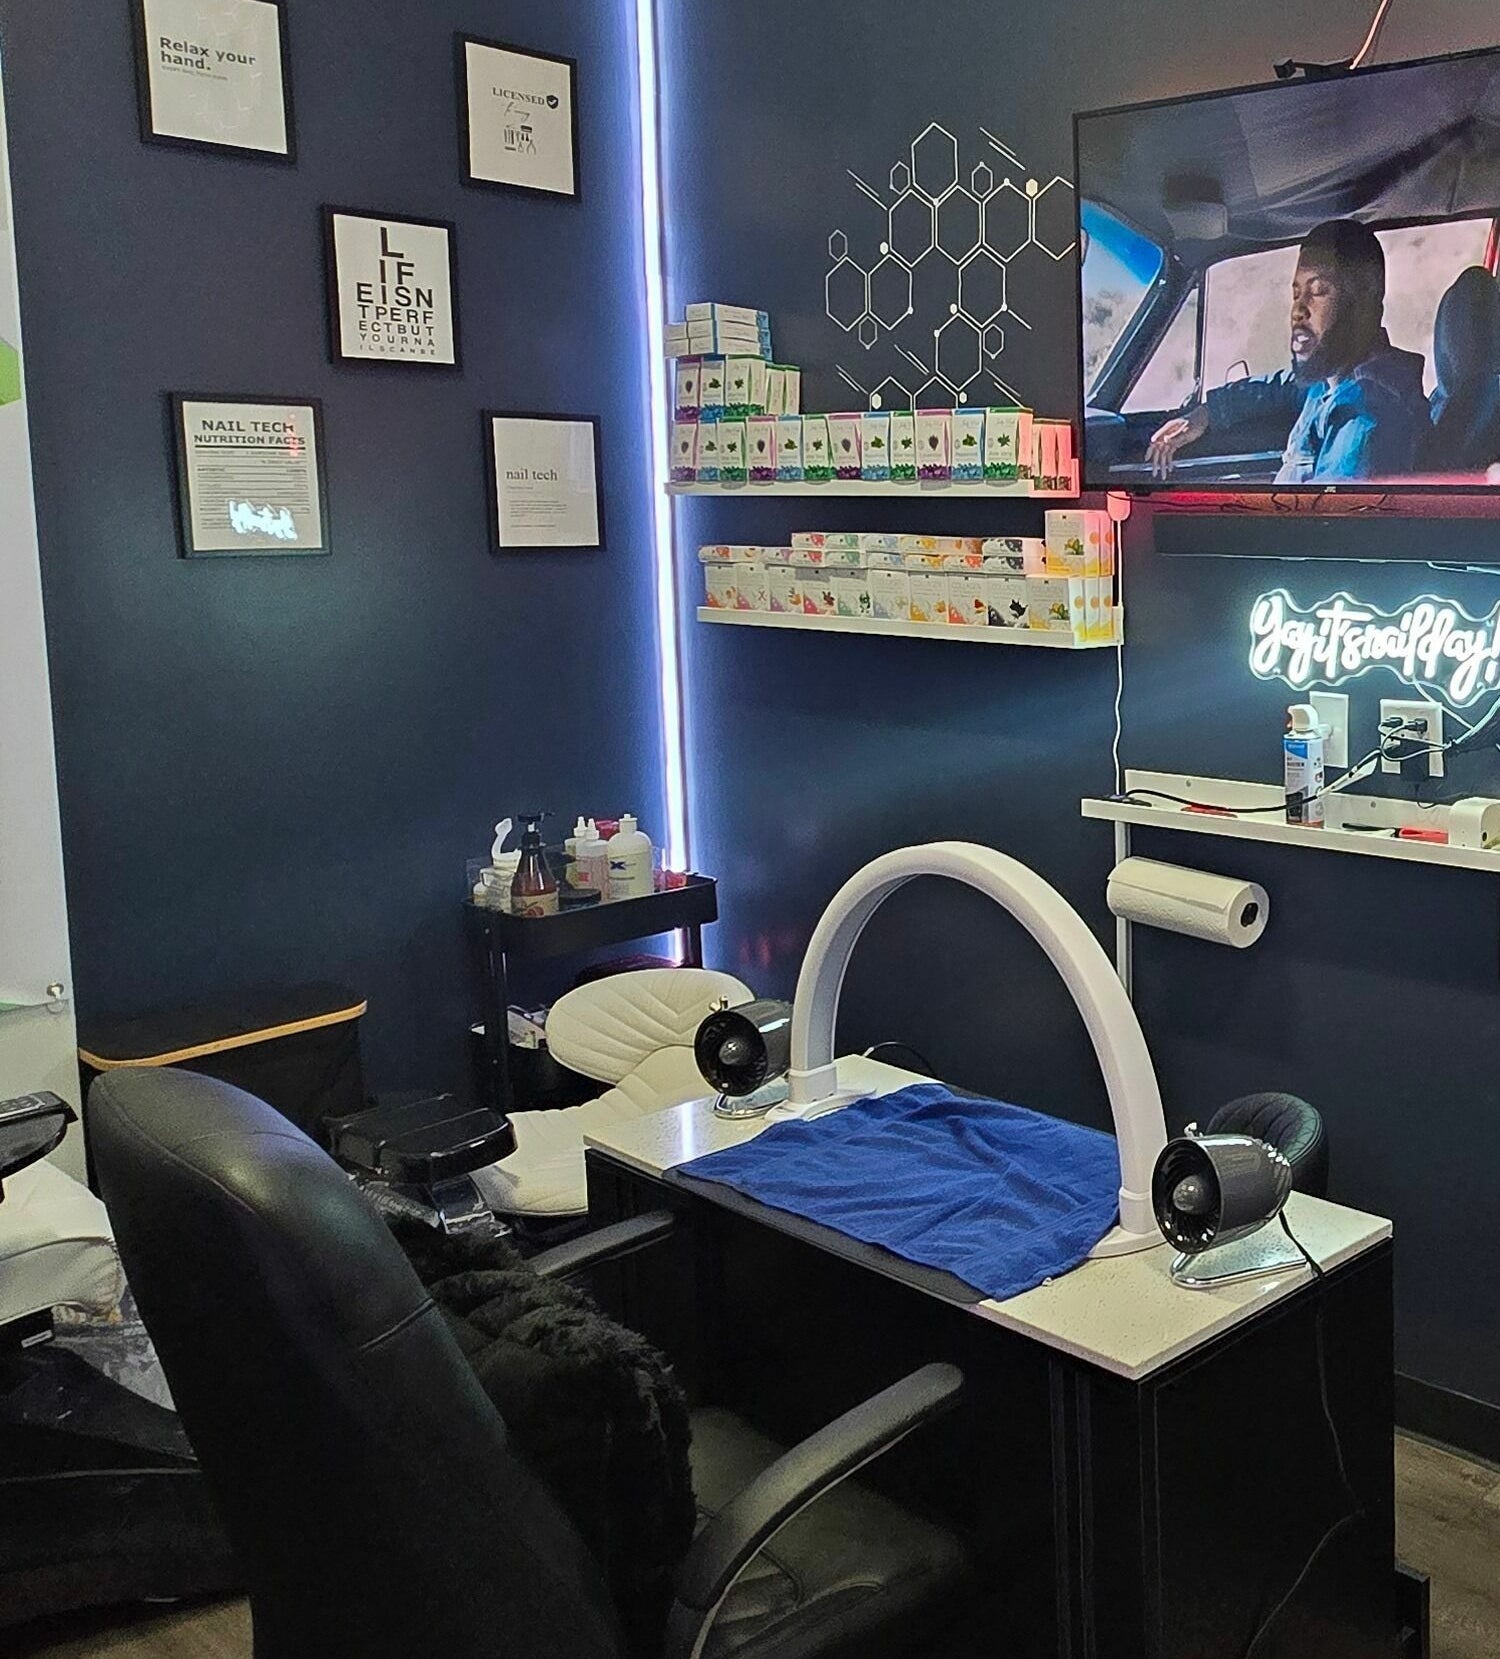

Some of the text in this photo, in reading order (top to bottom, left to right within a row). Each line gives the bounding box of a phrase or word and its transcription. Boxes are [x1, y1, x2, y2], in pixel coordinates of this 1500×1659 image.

[160, 36, 257, 66] Relax your
[160, 50, 212, 71] hand.
[492, 87, 545, 105] LICENSED
[380, 227, 404, 258] L
[357, 304, 434, 324] TPERF
[359, 320, 434, 336] ECTBUT
[360, 333, 435, 346] YOURNA
[202, 419, 294, 433] NAIL TECH
[194, 434, 306, 445] NUTRITION FACTS
[506, 468, 558, 481] nail tech
